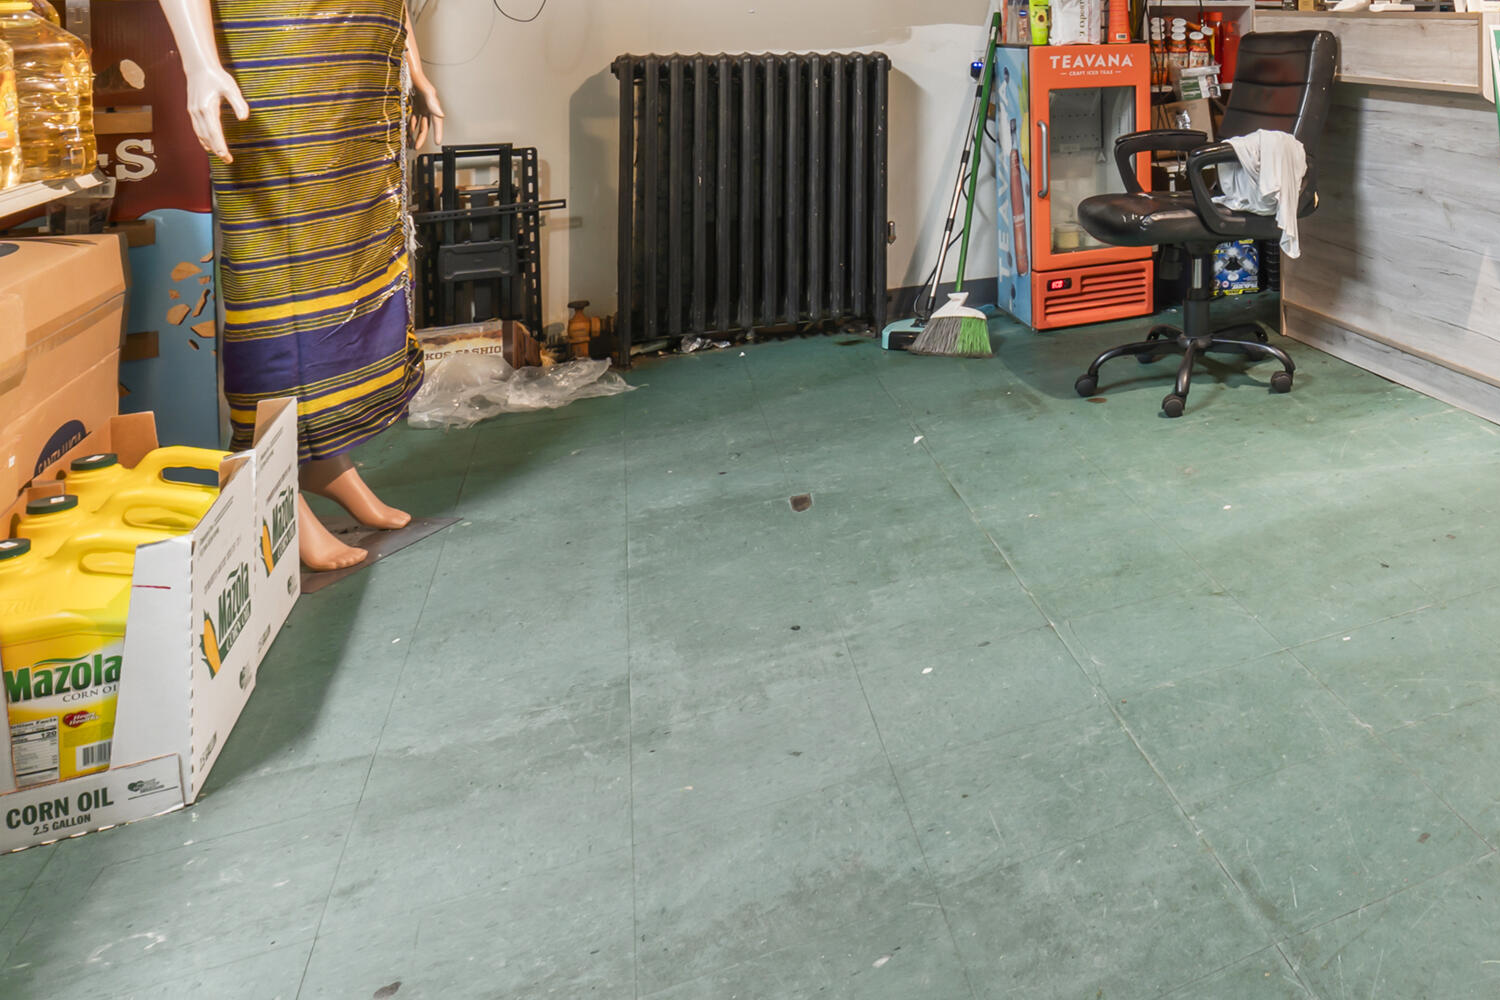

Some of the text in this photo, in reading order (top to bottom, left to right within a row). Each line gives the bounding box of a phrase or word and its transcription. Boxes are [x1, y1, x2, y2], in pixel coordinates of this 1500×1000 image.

[1049, 54, 1133, 69] TEAVANA
[998, 80, 1011, 284] TEAVAA
[4, 653, 122, 703] Mazola
[62, 685, 118, 703] CORN OI
[6, 787, 114, 830] CORN OIL
[32, 813, 91, 836] 2.5 GALLON
